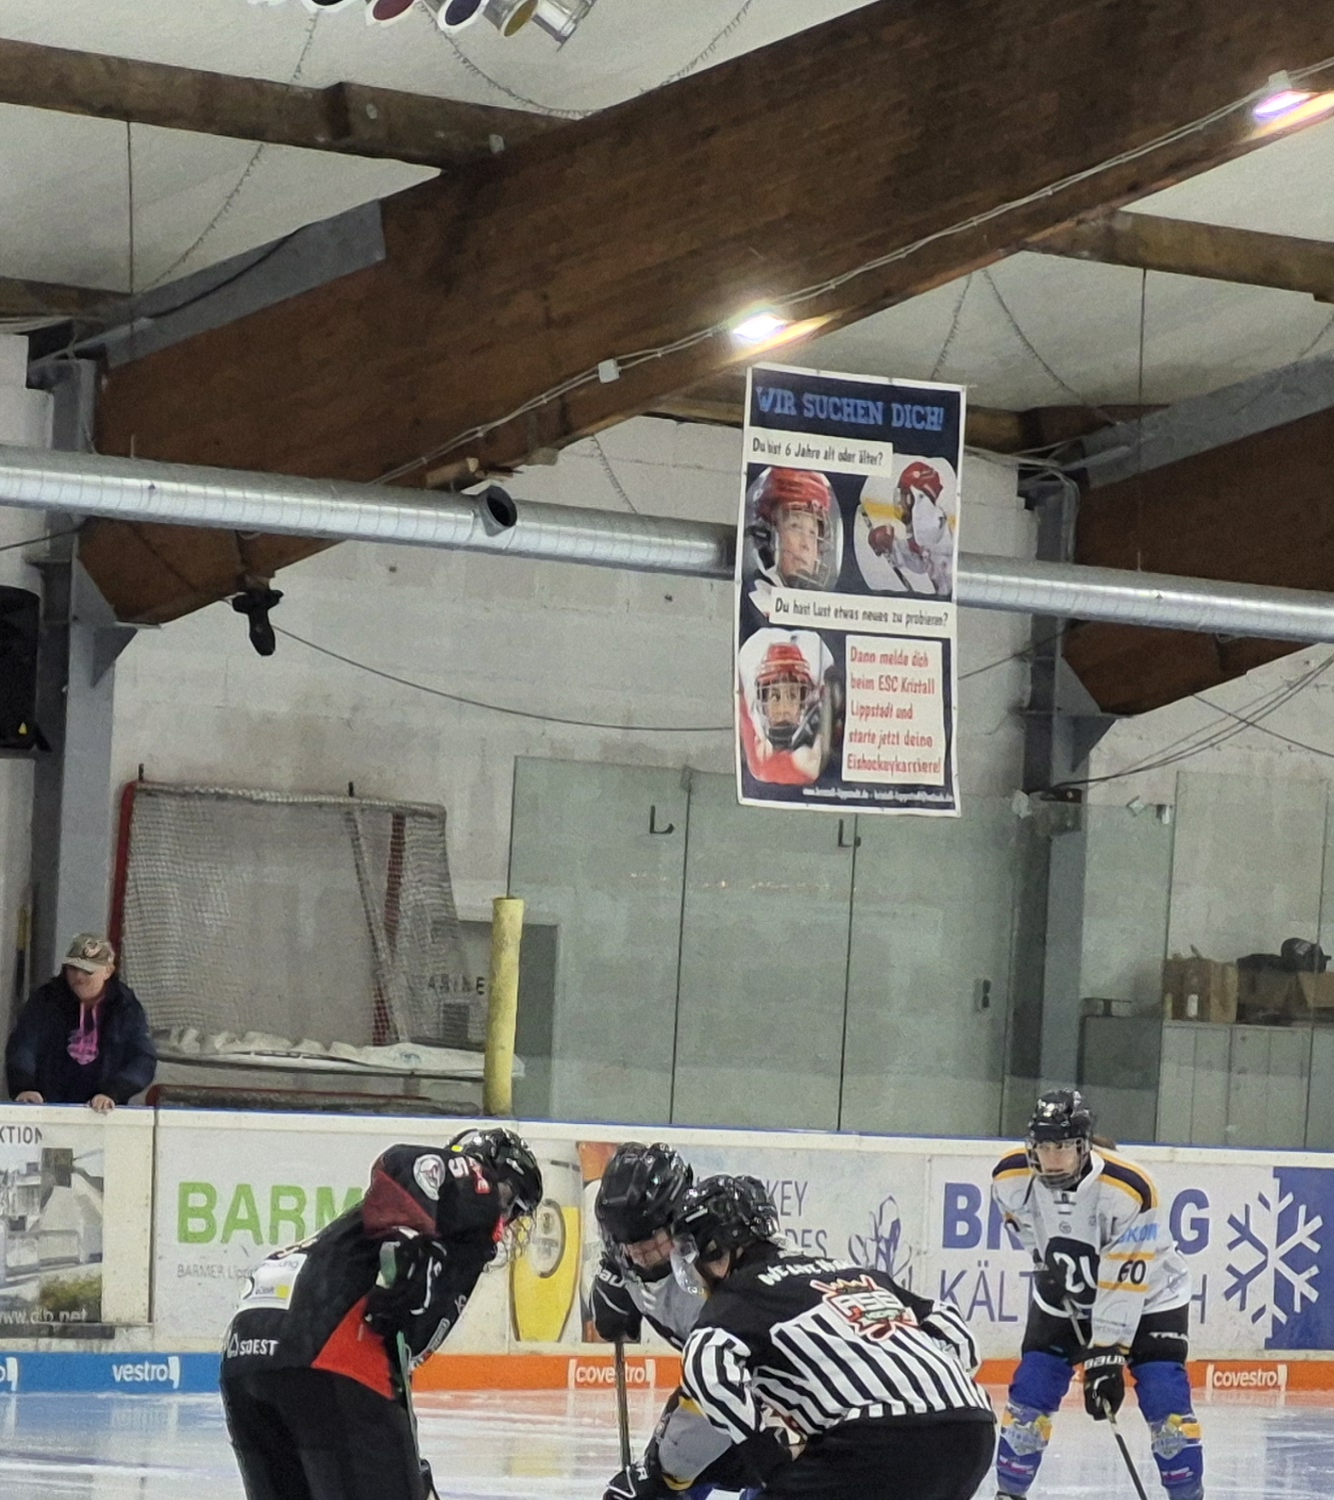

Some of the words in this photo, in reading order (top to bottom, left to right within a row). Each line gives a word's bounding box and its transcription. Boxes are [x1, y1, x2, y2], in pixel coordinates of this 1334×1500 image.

[756, 386, 796, 415] WIR
[803, 392, 884, 426] SUCHEN
[892, 403, 944, 431] DICH!
[752, 437, 766, 452] Du
[768, 439, 782, 456] bist
[785, 443, 792, 456] 6
[795, 442, 820, 460] Jahre
[823, 446, 835, 460] alt
[838, 447, 857, 463] oder
[859, 449, 884, 466] älter?
[775, 597, 790, 614] Du
[793, 598, 811, 615] hast
[813, 601, 831, 617] Lust
[834, 605, 859, 620] etwas
[862, 609, 888, 623] neues
[892, 611, 903, 624] zu
[905, 610, 949, 629] probieren?
[850, 646, 876, 664] Dann
[879, 649, 909, 666] melde
[911, 651, 929, 667] dich
[850, 675, 875, 691] beim
[878, 675, 898, 693] ESC
[901, 676, 936, 694] Kristall
[851, 699, 894, 721] Lippstadt
[895, 703, 913, 720] und
[849, 730, 876, 745] starte
[878, 730, 901, 749] jetzt
[904, 730, 933, 748] deine
[847, 754, 941, 777] Eishockeykarriere!
[576, 1361, 646, 1383] covetro
[1213, 1368, 1278, 1390] covestro
